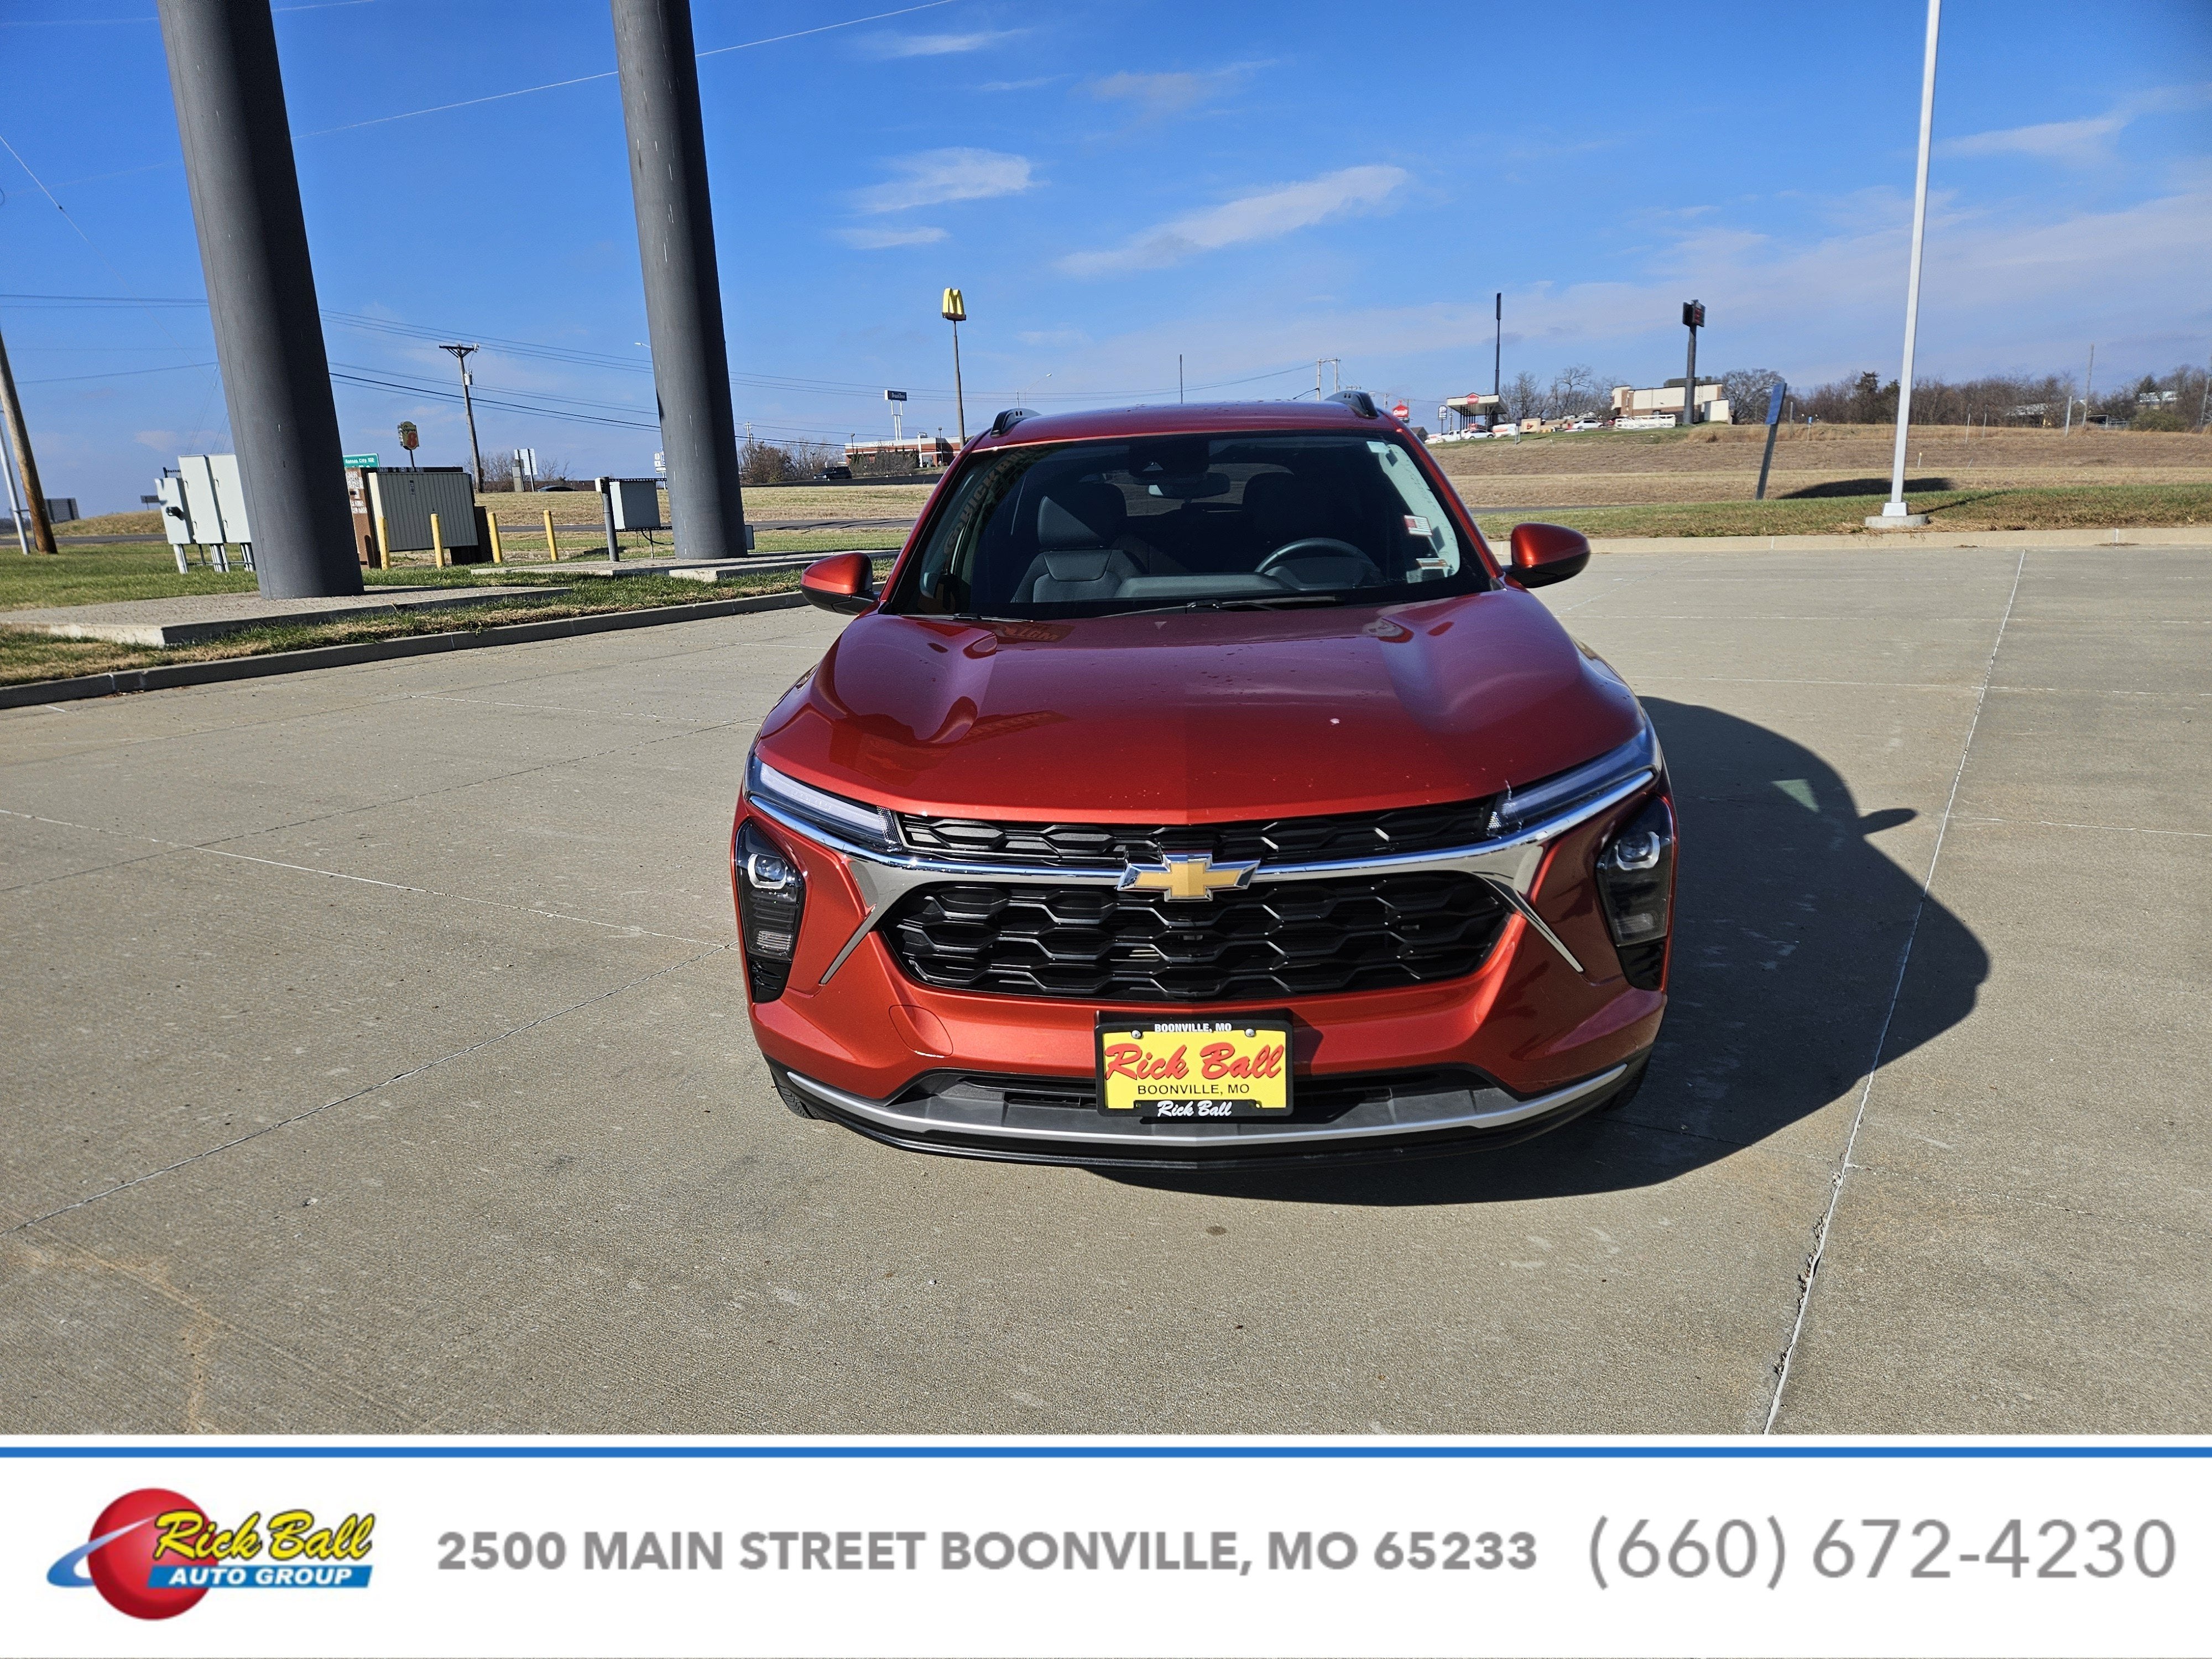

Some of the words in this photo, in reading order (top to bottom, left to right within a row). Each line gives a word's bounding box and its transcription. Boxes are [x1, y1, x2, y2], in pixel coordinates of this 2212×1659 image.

[407, 431, 418, 448] 8
[1154, 1024, 1213, 1033] BOONVILLE,
[1215, 1023, 1232, 1032] MO
[1104, 1044, 1190, 1081] Rick
[1199, 1042, 1285, 1080] Ball
[1138, 1084, 1224, 1096] BOONVILLE,
[1228, 1084, 1250, 1094] MO
[1157, 1100, 1194, 1117] Rick
[1197, 1100, 1232, 1117] Ball
